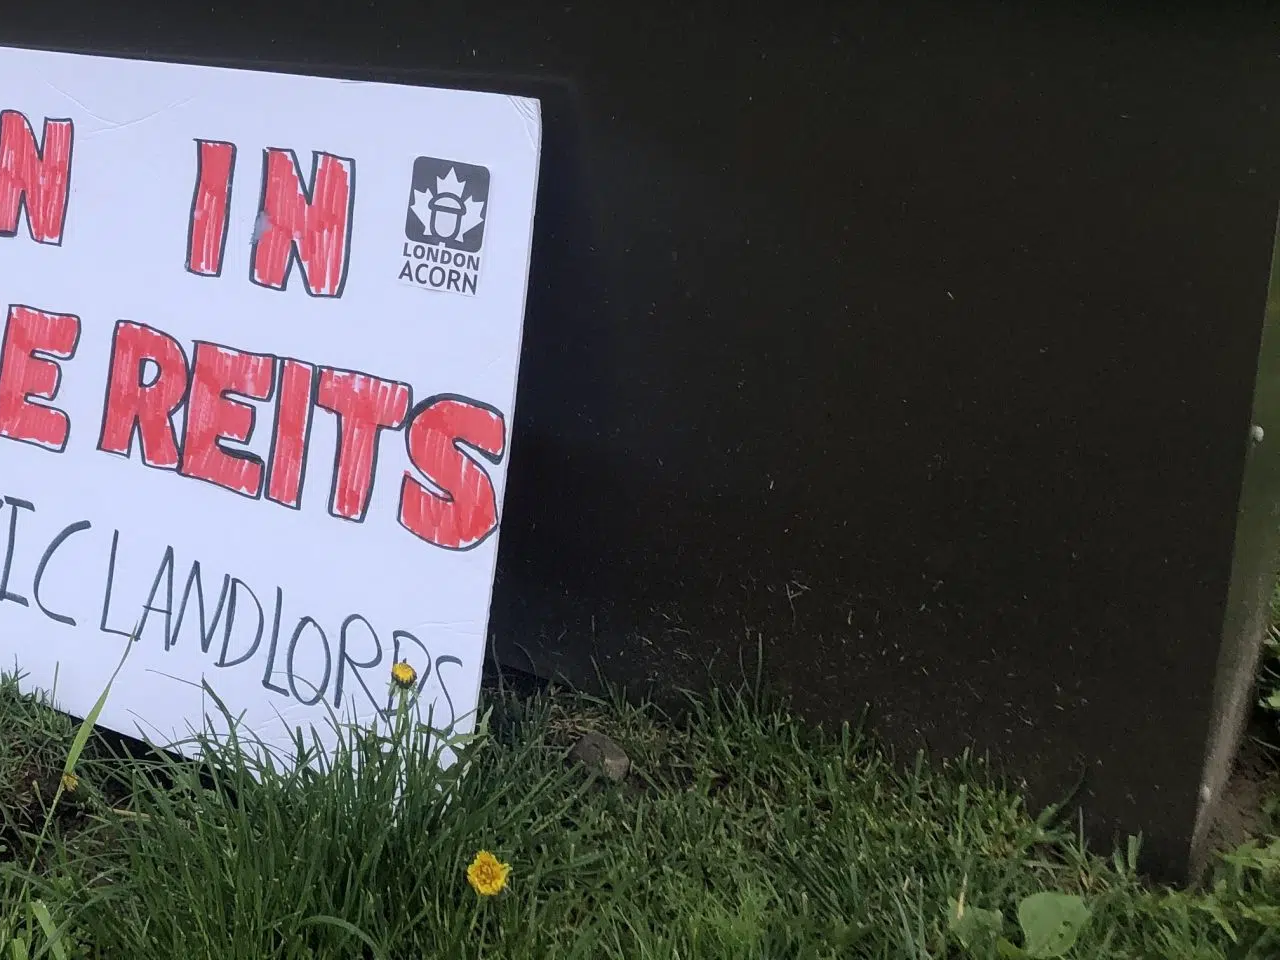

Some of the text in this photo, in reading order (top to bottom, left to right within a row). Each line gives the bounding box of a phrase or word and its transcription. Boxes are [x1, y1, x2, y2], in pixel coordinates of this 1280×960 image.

[184, 138, 355, 298] IN
[402, 242, 481, 272] LONDON
[397, 259, 478, 296] ACORN
[96, 319, 506, 551] REITS
